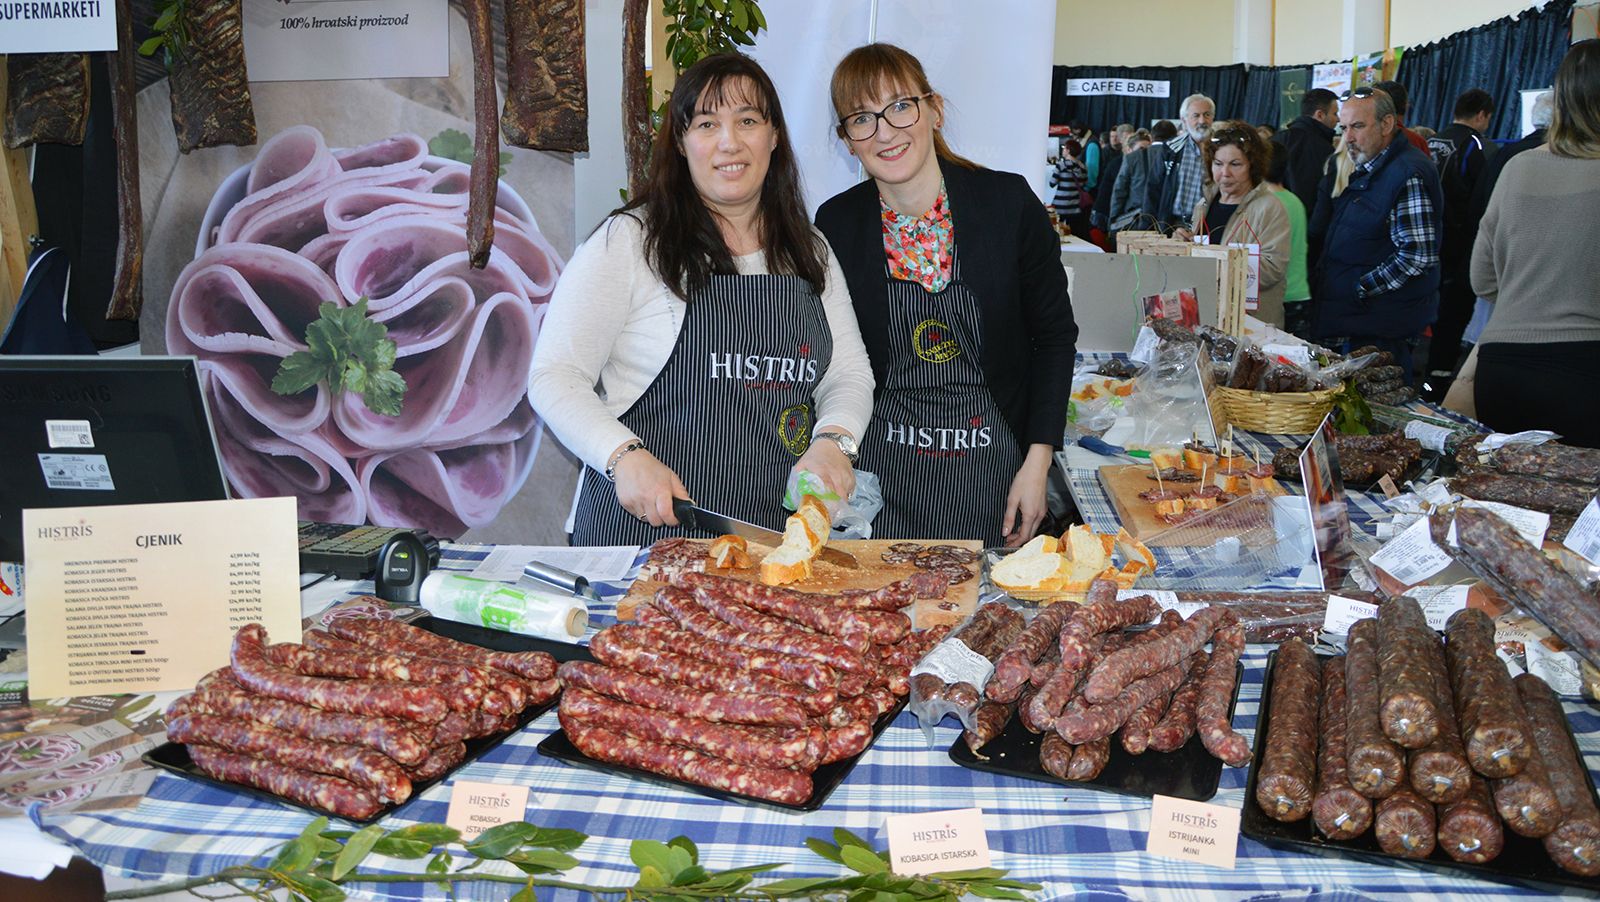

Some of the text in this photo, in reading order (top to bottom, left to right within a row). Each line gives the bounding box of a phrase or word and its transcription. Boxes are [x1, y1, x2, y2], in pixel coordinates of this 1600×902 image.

[280, 14, 409, 30] 100% hrvatski proizvod
[1082, 81, 1123, 92] CAFFE
[1127, 82, 1154, 93] BAR
[710, 352, 818, 382] HISTRIS
[886, 421, 991, 450] HISTRIS
[38, 525, 93, 538] HISTRIS
[136, 534, 182, 548] CJENIK
[1350, 605, 1377, 617] HISTRI
[468, 795, 510, 807] HISTRIS
[470, 814, 502, 823] KOBASICA
[1171, 812, 1218, 828] HISTRIS
[912, 829, 958, 841] HISTRIS
[1168, 830, 1216, 845] ISTRIJANKA
[900, 850, 978, 863] KOBASICA ISTARSKA
[1182, 846, 1200, 855] MINI
